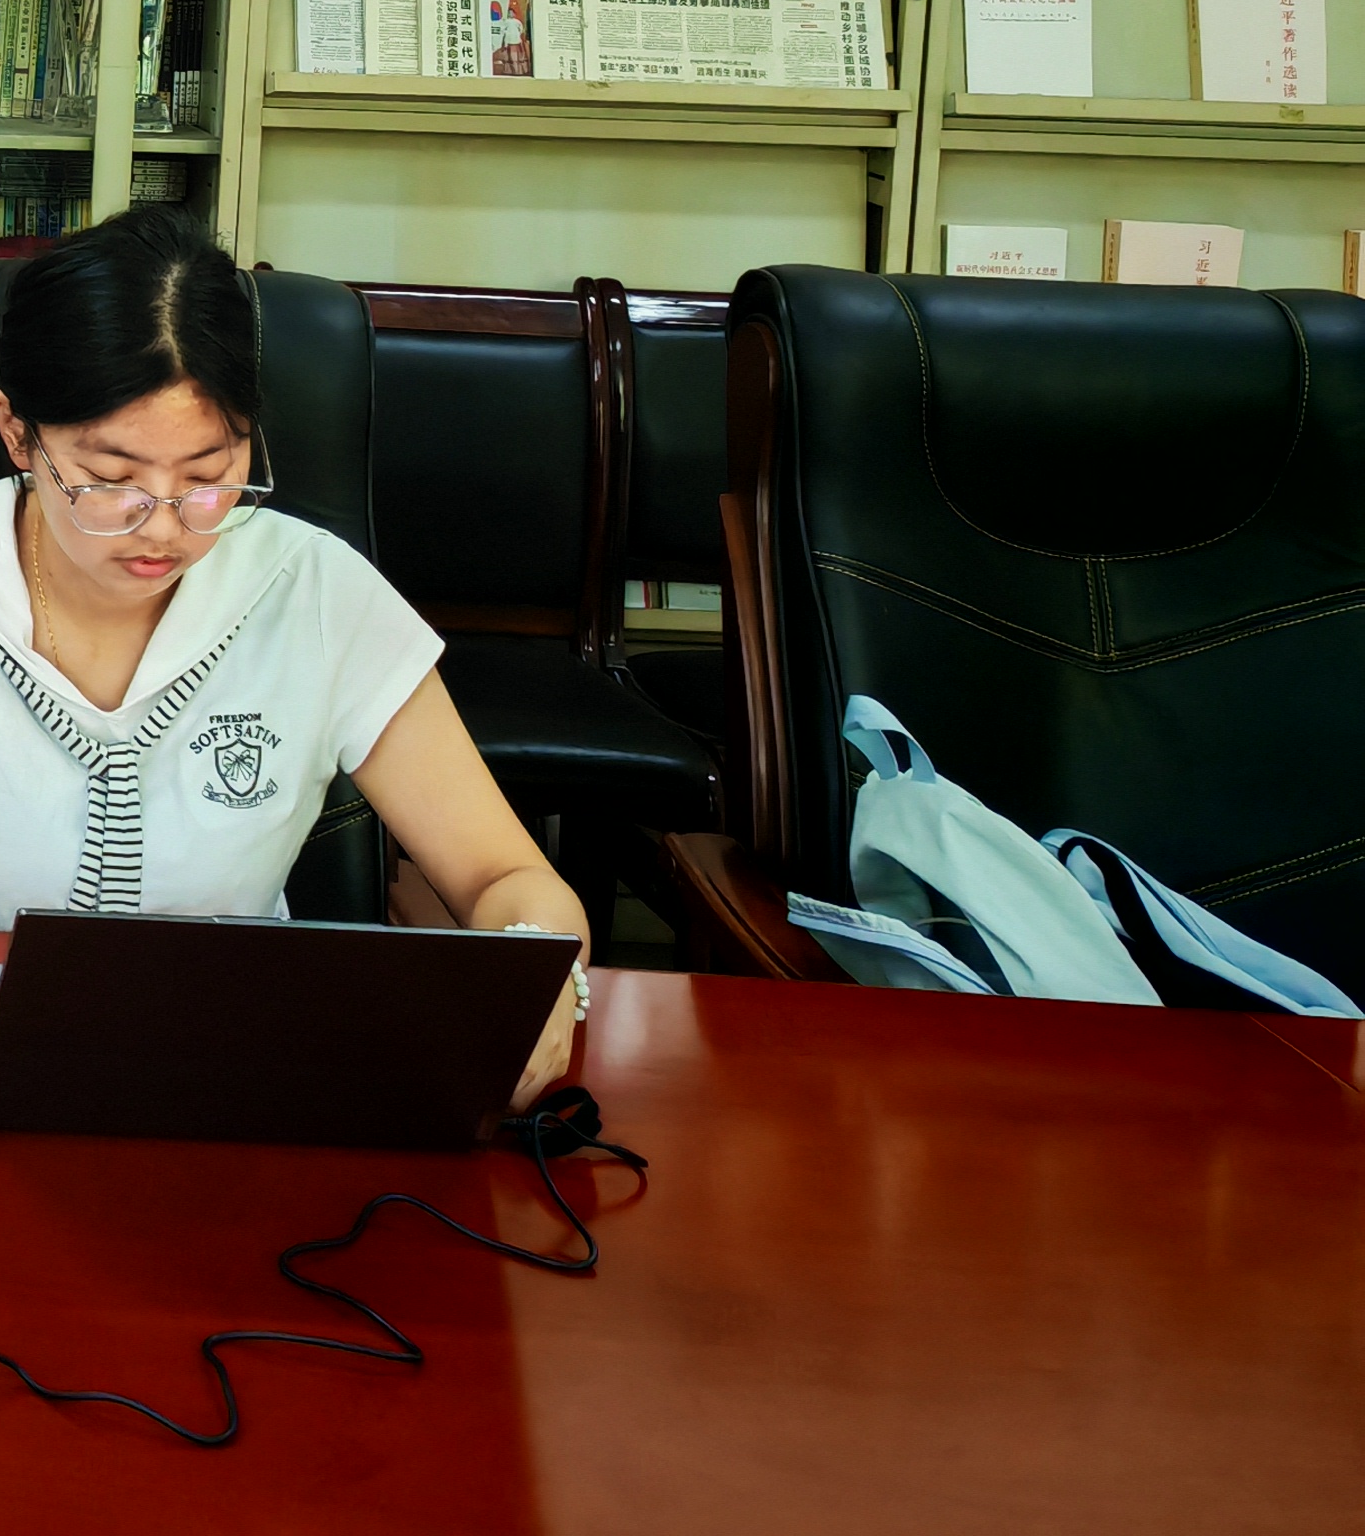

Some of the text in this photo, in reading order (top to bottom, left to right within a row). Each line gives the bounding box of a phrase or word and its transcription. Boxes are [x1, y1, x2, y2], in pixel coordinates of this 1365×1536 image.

[989, 250, 1024, 262] 习近平
[209, 712, 263, 724] FREEDOM
